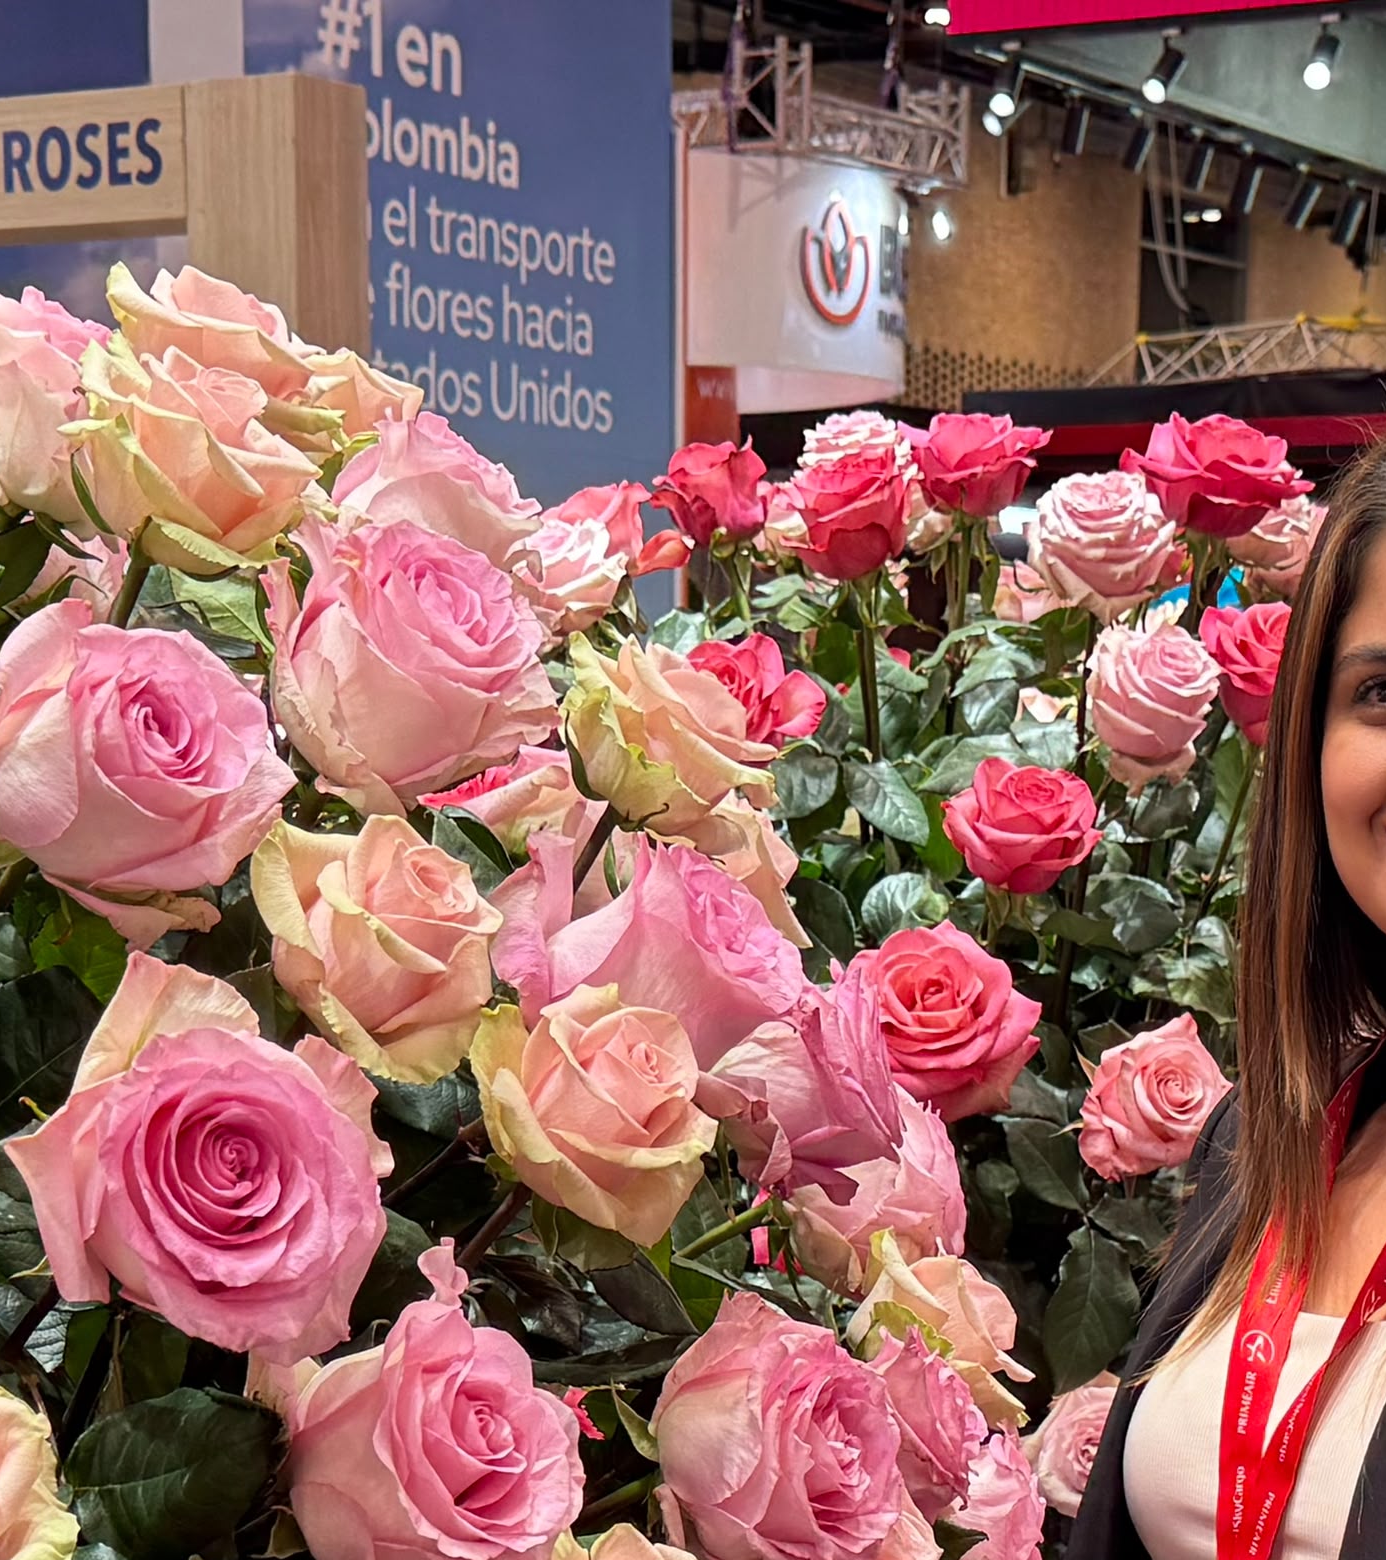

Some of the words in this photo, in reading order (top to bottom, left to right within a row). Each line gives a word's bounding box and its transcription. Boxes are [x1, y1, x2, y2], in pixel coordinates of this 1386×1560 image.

[317, 0, 382, 77] #1
[397, 24, 461, 97] en
[2, 118, 163, 193] ROSES
[365, 98, 519, 190] olombia
[383, 186, 416, 248] el
[426, 196, 615, 285] transporte
[385, 261, 494, 341] flores
[502, 283, 593, 356] hacia
[490, 360, 613, 433] Unidos
[1237, 1371, 1257, 1435] PRIMEAIR
